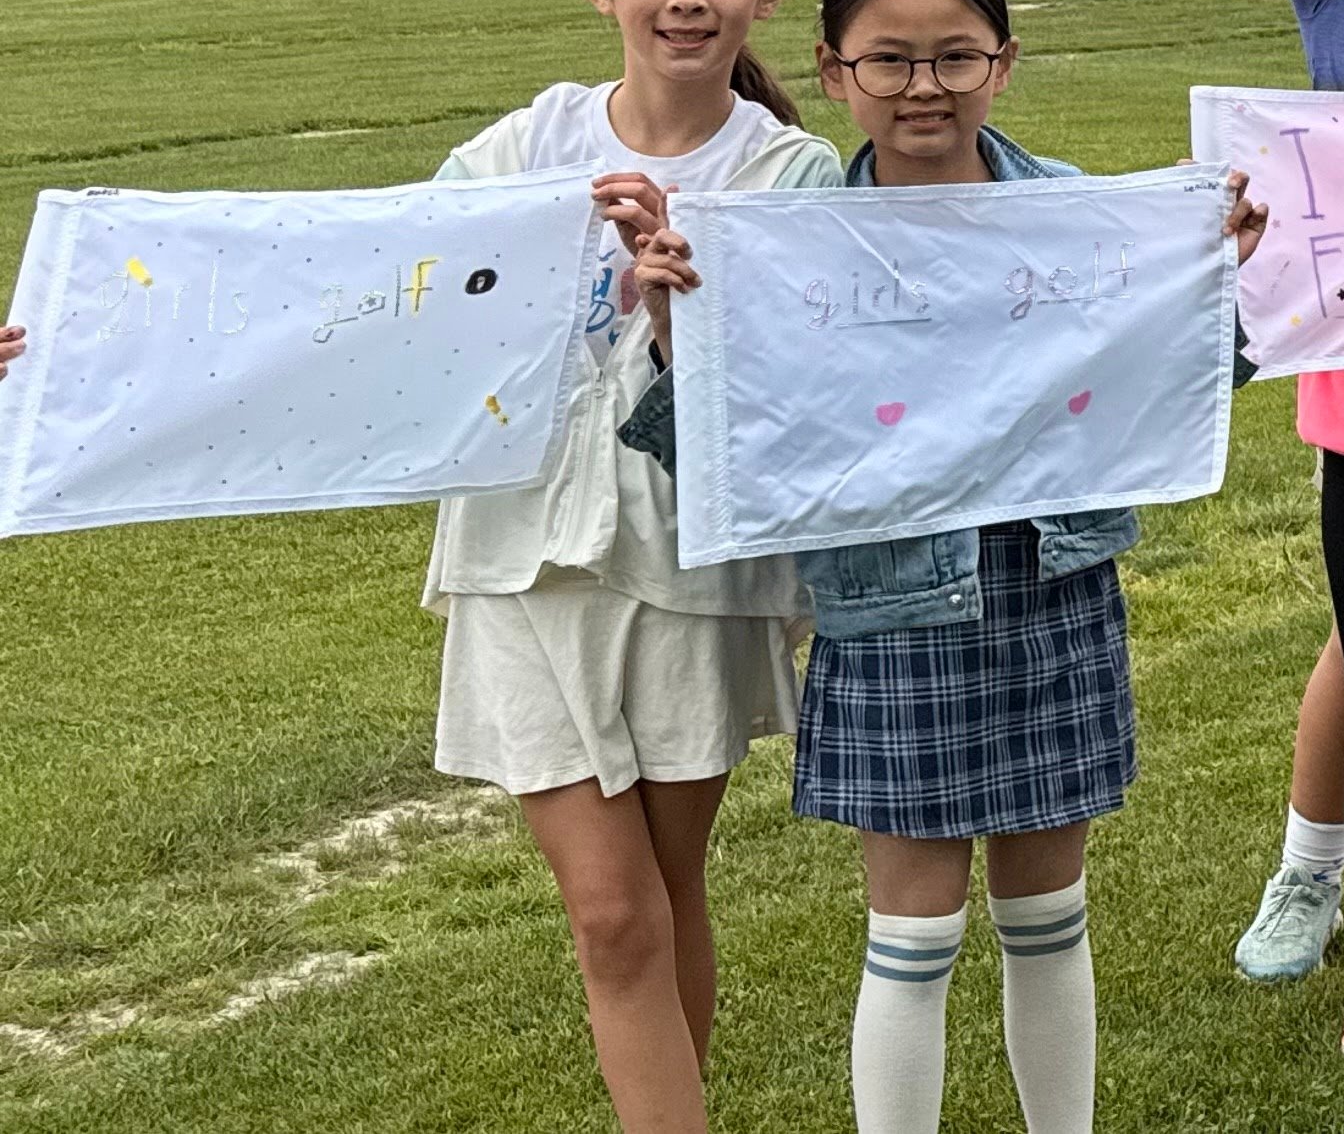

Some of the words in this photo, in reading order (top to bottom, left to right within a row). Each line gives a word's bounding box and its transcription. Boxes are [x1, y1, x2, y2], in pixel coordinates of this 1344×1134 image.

[1279, 127, 1325, 220] I
[804, 259, 931, 331] girls
[1003, 241, 1137, 322] golf
